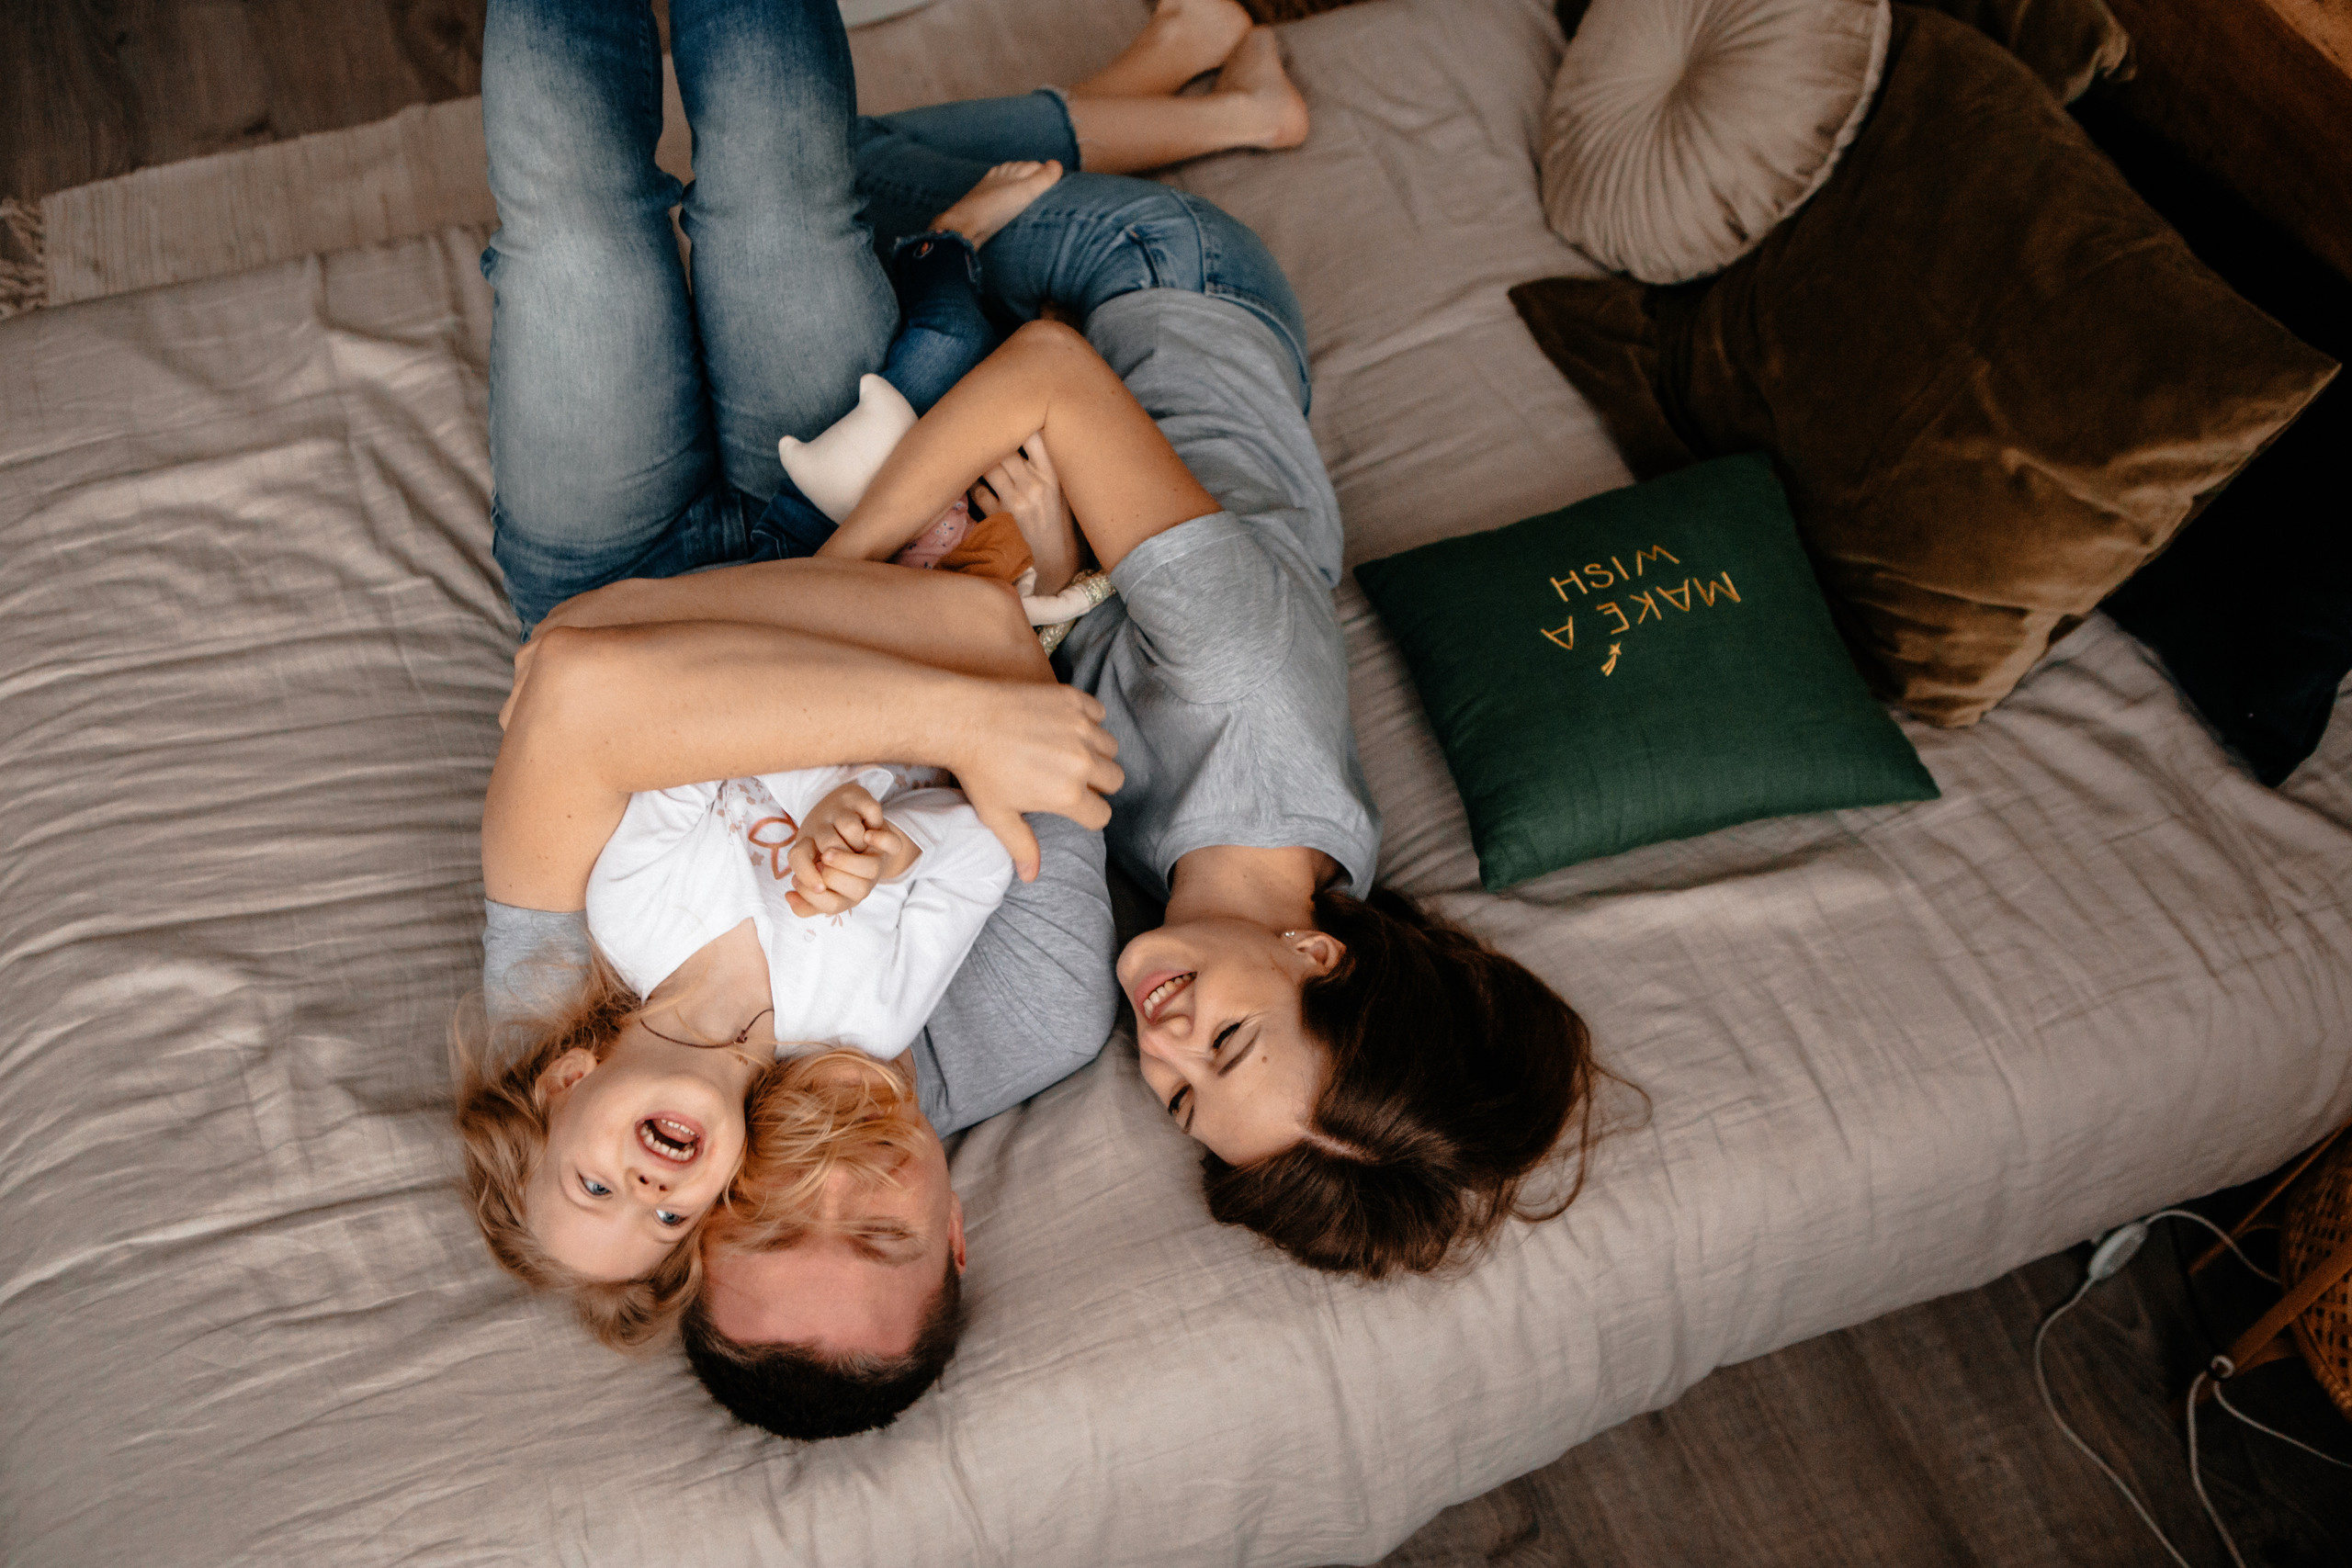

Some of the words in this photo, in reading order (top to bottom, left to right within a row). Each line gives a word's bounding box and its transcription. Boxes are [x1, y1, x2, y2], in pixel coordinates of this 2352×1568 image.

[1550, 545, 1680, 603] WISH
[1596, 570, 1742, 636] MAKE
[1540, 615, 1574, 650] A
